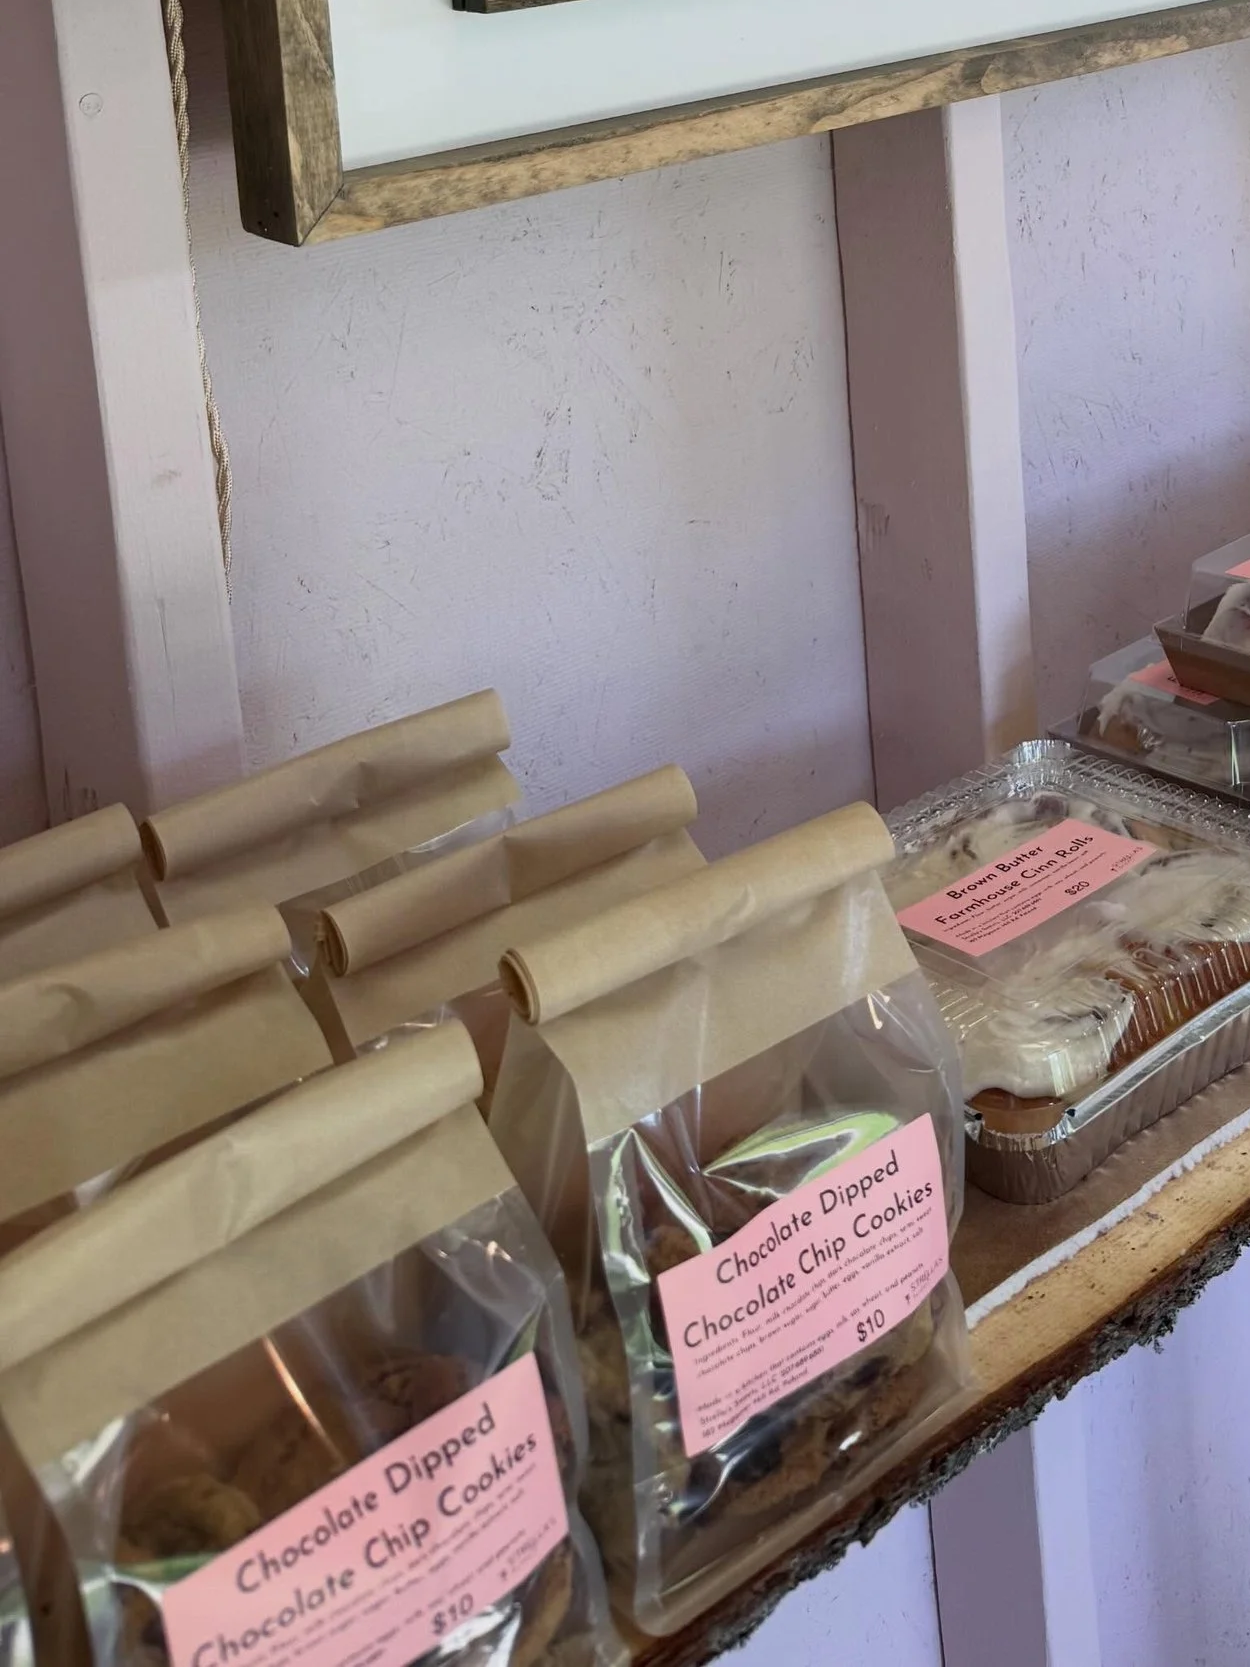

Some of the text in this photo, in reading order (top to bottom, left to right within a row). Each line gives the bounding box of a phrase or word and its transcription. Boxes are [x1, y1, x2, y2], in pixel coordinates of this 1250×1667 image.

[934, 878, 1022, 926] Farmhouse
[1020, 858, 1058, 880] Cinn
[1055, 834, 1094, 860] Rolls
[946, 844, 1044, 901] Brown Butter
[1064, 880, 1090, 896] $20
[716, 1149, 899, 1284] Chocolate Dipped
[683, 1182, 933, 1348] Chocolate Chip Cookies
[856, 1308, 885, 1342] $10
[236, 1491, 379, 1594] Chocolate
[384, 1403, 496, 1496] Dipped
[192, 1568, 356, 1667] Chocolate
[364, 1517, 430, 1569] Chip
[437, 1433, 538, 1517] Cookies
[432, 1592, 474, 1636] $10
